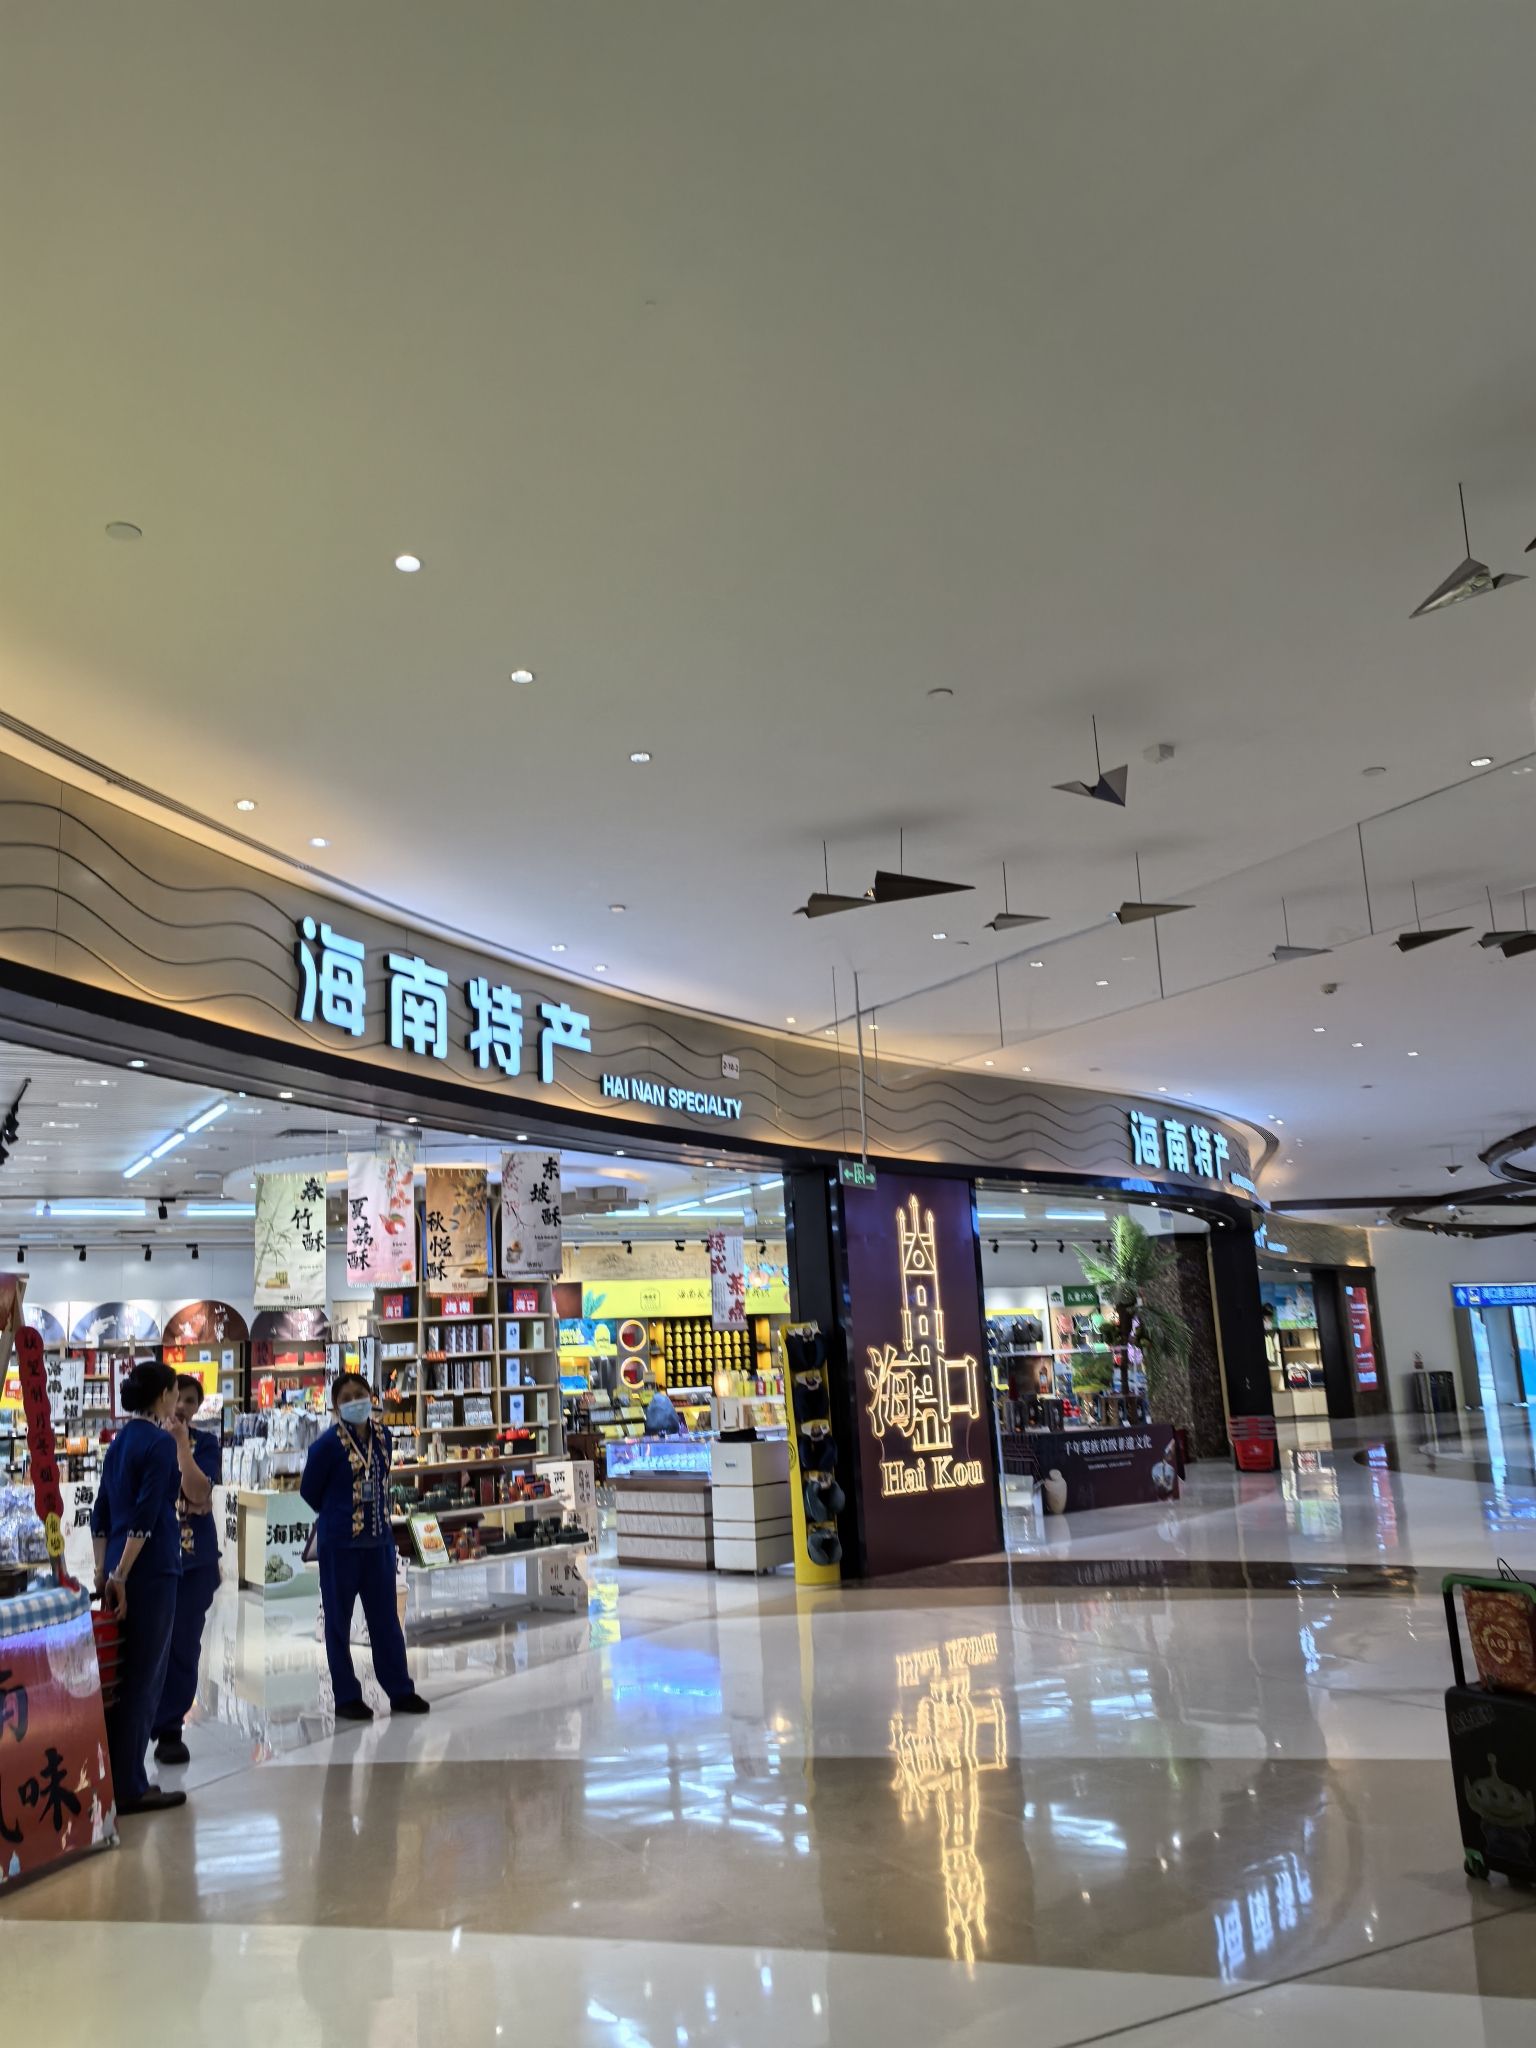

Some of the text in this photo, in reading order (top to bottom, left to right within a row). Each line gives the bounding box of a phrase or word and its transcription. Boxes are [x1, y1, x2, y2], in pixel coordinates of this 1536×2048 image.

[300, 916, 592, 1084] 海南特产
[602, 1073, 743, 1120] HAI NAN SPECIALTY
[1130, 1110, 1230, 1180] 海南特产
[291, 1177, 326, 1252] 春竹酥
[347, 1196, 374, 1271] 夏荔酥
[426, 1211, 452, 1280] 秋悦酥
[881, 1455, 984, 1496] Hai Kou
